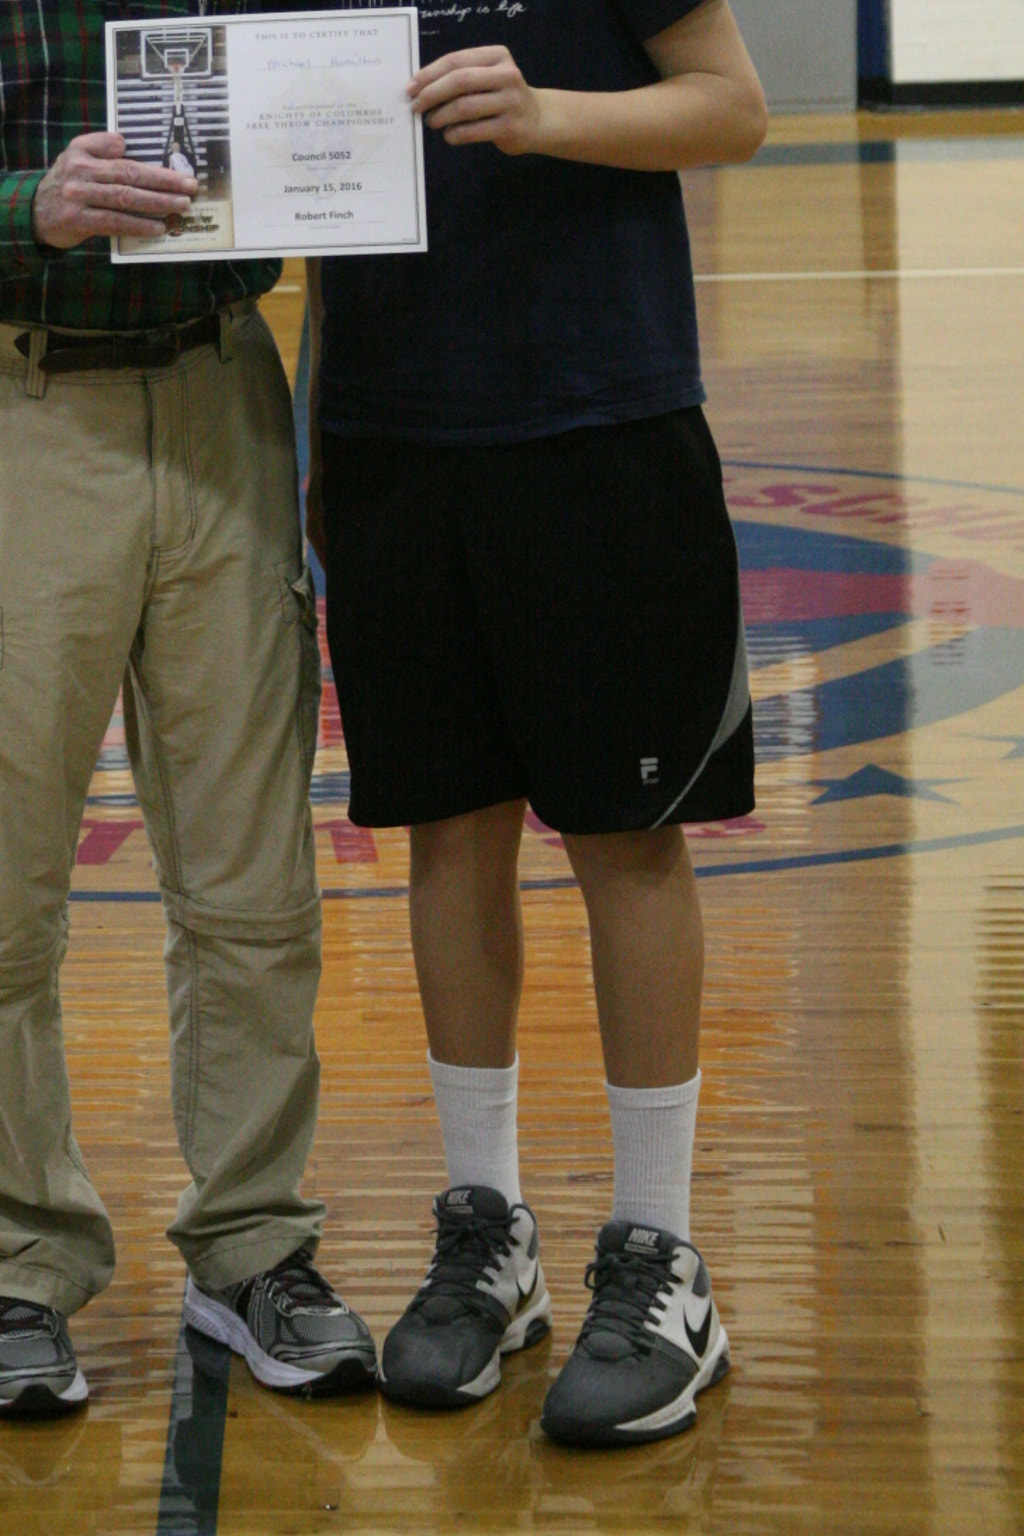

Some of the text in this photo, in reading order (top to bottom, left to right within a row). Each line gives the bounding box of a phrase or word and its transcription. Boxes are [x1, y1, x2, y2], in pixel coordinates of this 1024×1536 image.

[476, 4, 491, 14] is
[494, 0, 527, 18] life
[309, 30, 350, 39] CERTIFY
[353, 29, 379, 37] THAT
[259, 112, 305, 120] KNIGHTS
[326, 109, 382, 118] COLUMBUS
[274, 120, 310, 129] THROW
[315, 118, 395, 128] CHAMPIONSHIP
[291, 151, 352, 162] Council 5052
[283, 182, 362, 194] January 15, 2016
[294, 210, 354, 221] Robert Finch
[447, 1189, 472, 1205] NIKE
[628, 1227, 660, 1247] NIKE
